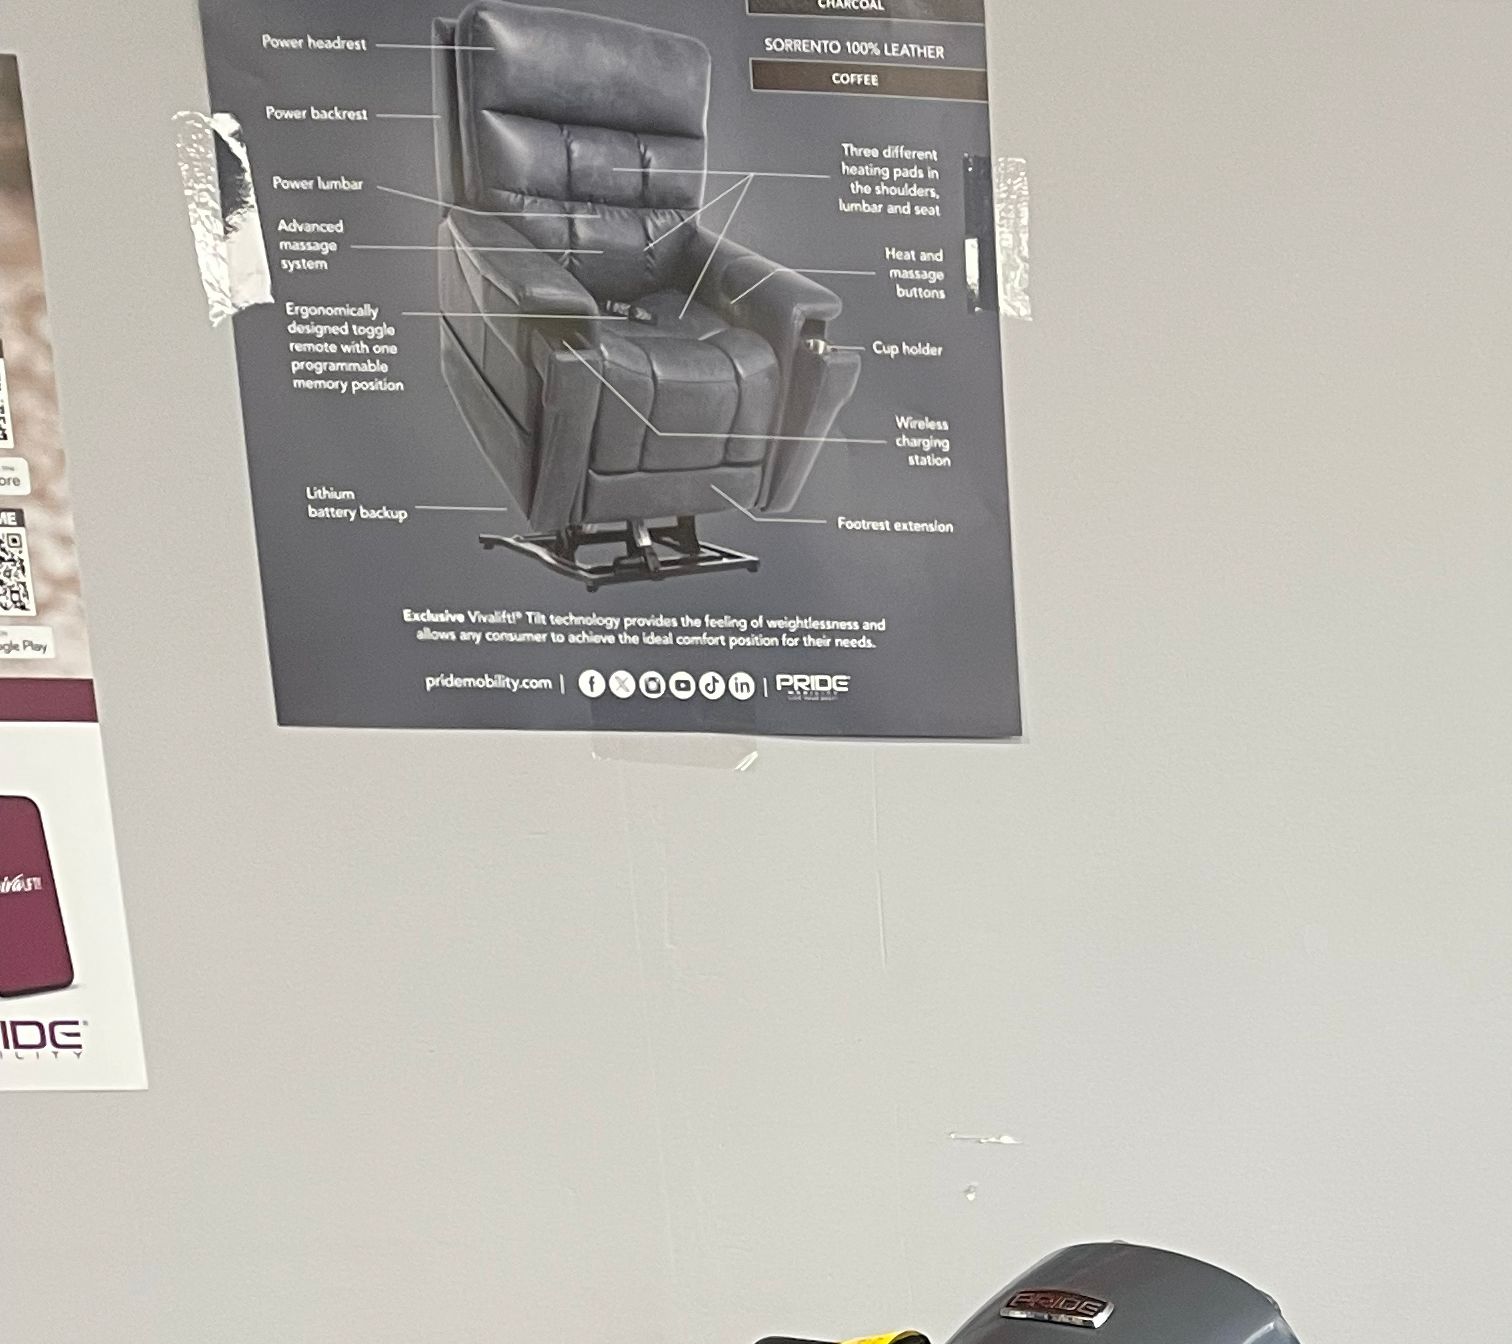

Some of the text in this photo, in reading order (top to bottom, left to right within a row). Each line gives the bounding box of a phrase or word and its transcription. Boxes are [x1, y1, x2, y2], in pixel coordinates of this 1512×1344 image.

[818, 0, 885, 11] CHARCOAL
[262, 34, 367, 51] Power headrest
[764, 37, 945, 60] SORRENTO 100% LEATHER
[832, 72, 879, 87] COFFEE
[266, 105, 368, 121] Power backrest
[841, 142, 938, 162] Three different
[841, 161, 940, 181] heating pads in
[273, 175, 363, 190] Power lumbar
[850, 180, 940, 200] the shoulders,
[838, 198, 941, 217] lumbar and seat
[277, 218, 344, 234] Advanced
[279, 240, 338, 255] massage
[885, 246, 944, 262] Heat and
[281, 258, 328, 273] system
[889, 268, 945, 284] massage
[896, 283, 946, 300] buttons
[285, 302, 379, 320] Ergonomically
[287, 320, 396, 339] designed toggle
[289, 340, 398, 355] remote with one
[872, 340, 943, 360] Cup holder
[291, 359, 389, 375] programmable
[293, 378, 404, 395] memory position
[895, 415, 949, 431] Wireless
[895, 434, 950, 452] charging
[908, 453, 951, 467] station
[306, 486, 355, 500] Lithium
[307, 504, 408, 523] battery backup
[837, 516, 954, 533] Footrest extension
[402, 608, 465, 623] Exclusive
[525, 611, 547, 625] Tilt
[549, 612, 621, 630] technology
[623, 613, 678, 630] provides
[680, 614, 701, 628] the
[704, 614, 748, 631] feeling
[750, 615, 764, 629] of
[766, 616, 860, 632] weightlessness
[862, 618, 886, 632] and
[416, 627, 877, 650] allows any consumer to achieve the ideal comfort position for their needs.
[425, 673, 553, 692] pridemobility.com
[775, 673, 851, 692] PRIDE
[1010, 1292, 1104, 1317] PRIDE
